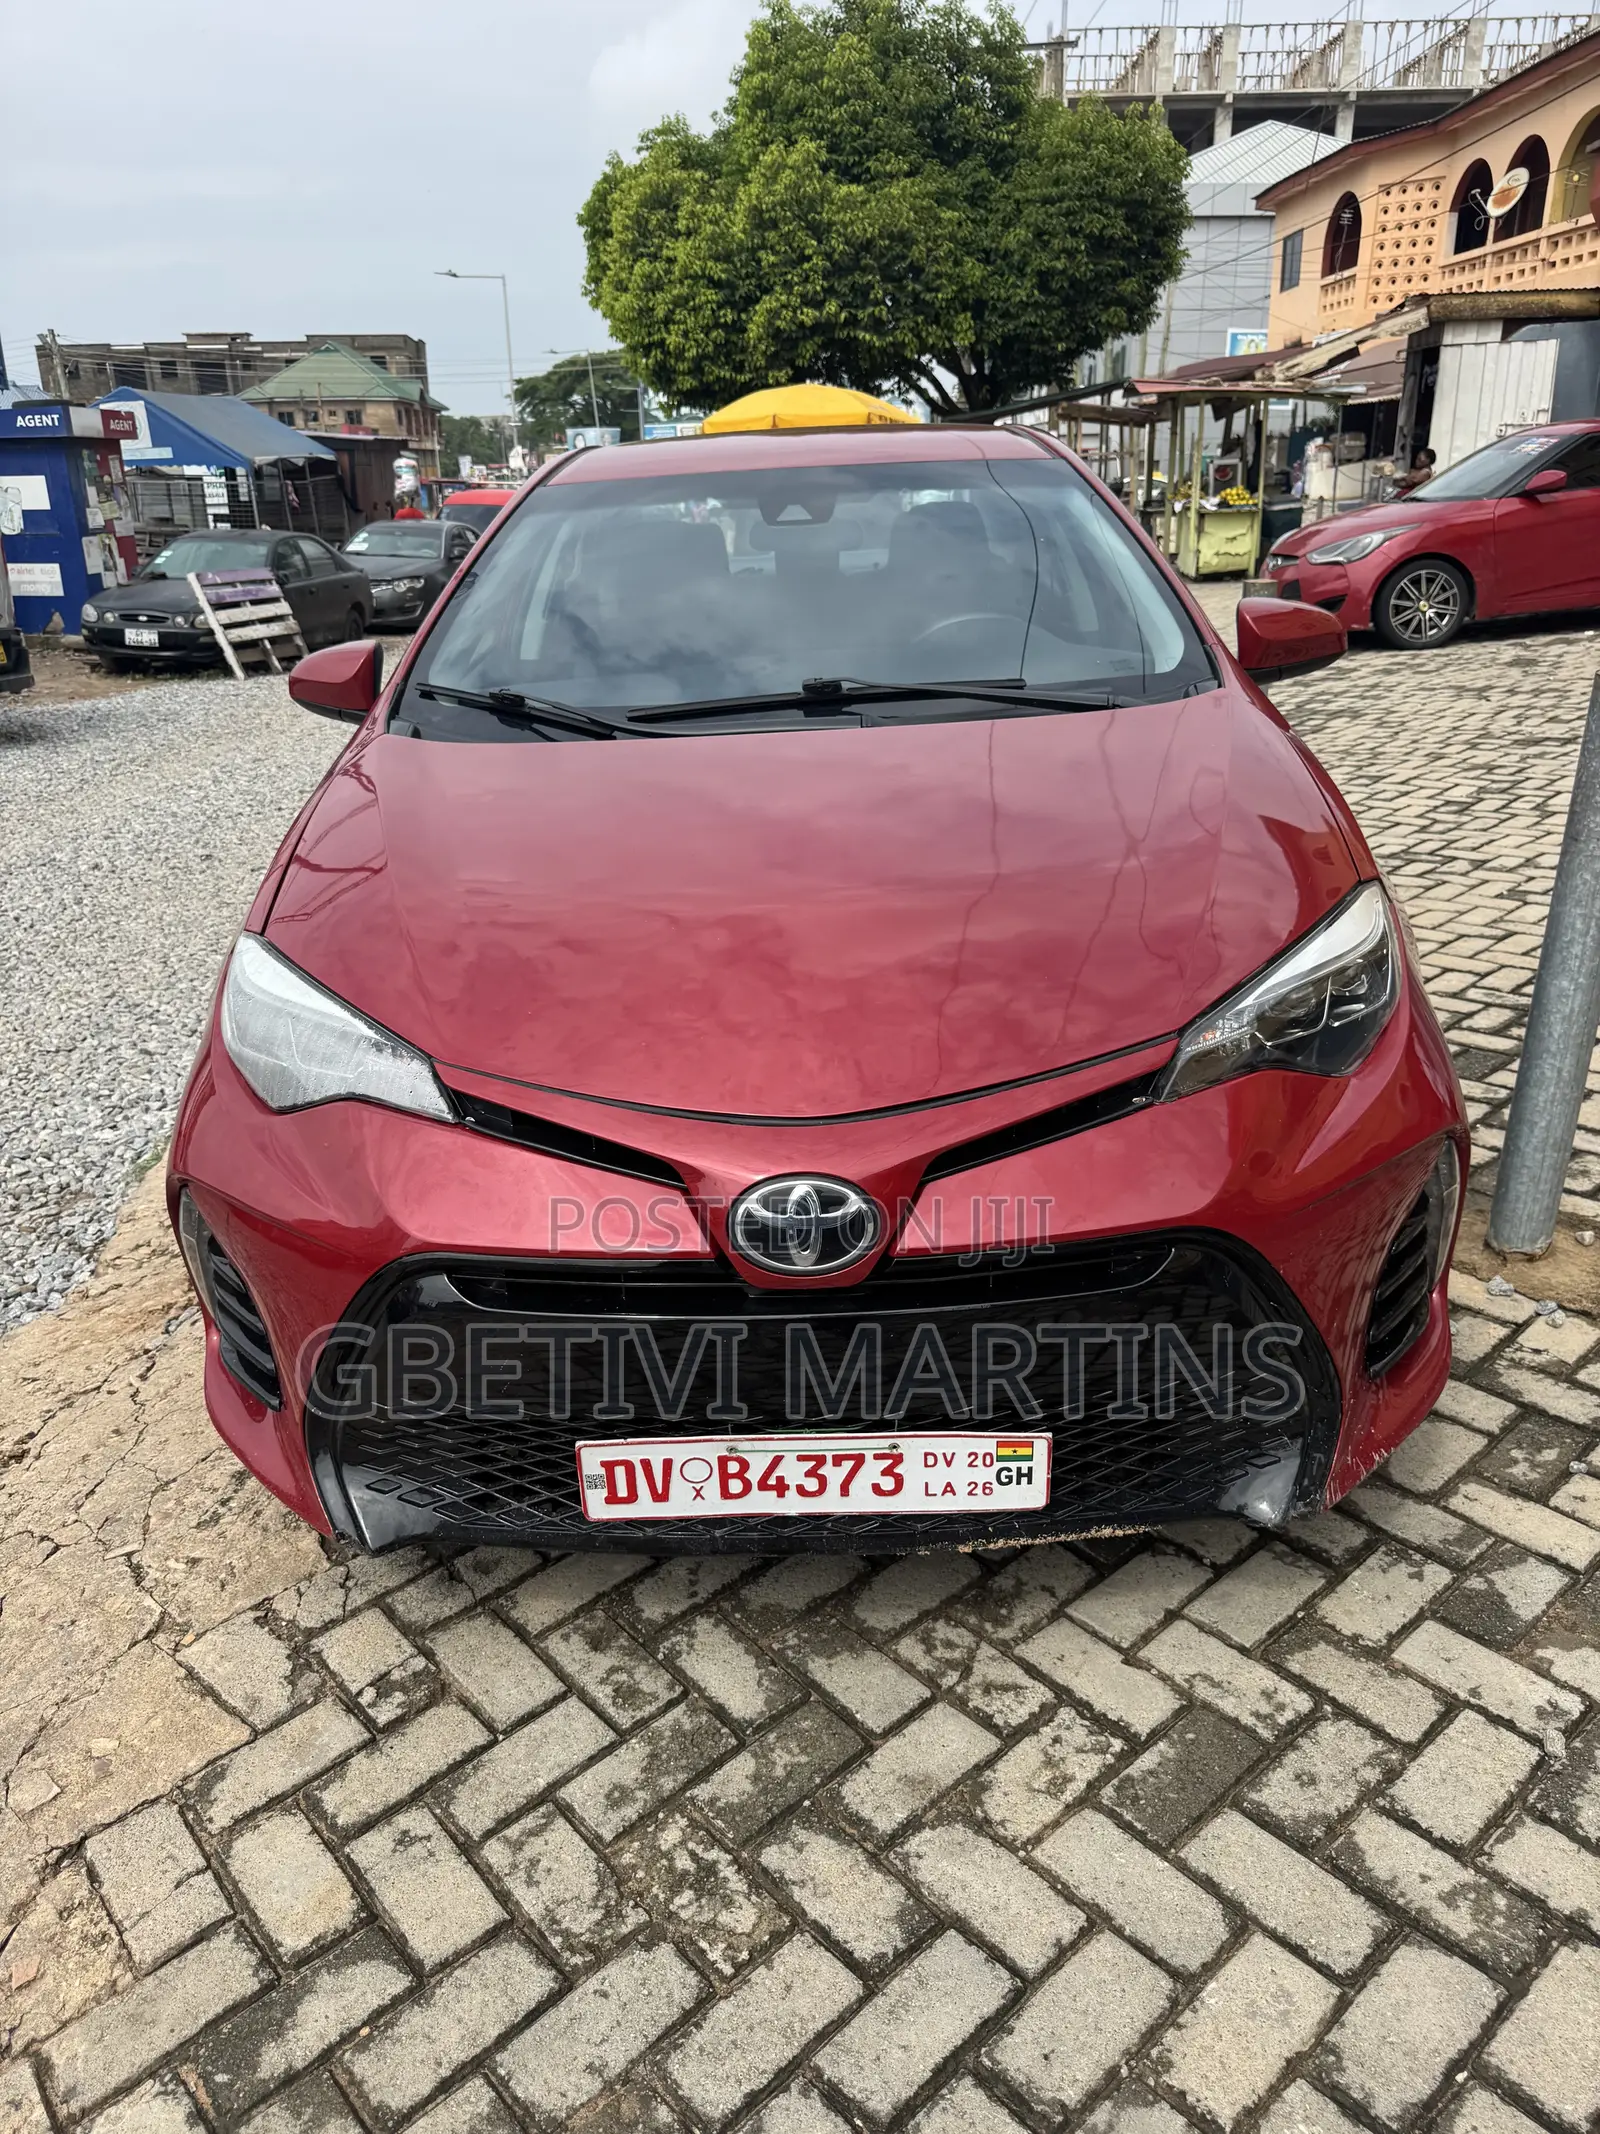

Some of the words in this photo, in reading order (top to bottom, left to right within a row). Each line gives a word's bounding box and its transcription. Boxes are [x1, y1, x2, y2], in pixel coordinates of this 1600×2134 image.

[16, 414, 60, 427] AGENT
[109, 419, 133, 431] AGENT
[923, 1451, 957, 1468] DV
[967, 1451, 994, 1468] 20
[600, 1457, 674, 1505] DV
[717, 1452, 904, 1500] B4373
[995, 1466, 1033, 1486] GH
[924, 1481, 957, 1497] LA
[967, 1481, 994, 1497] 26
